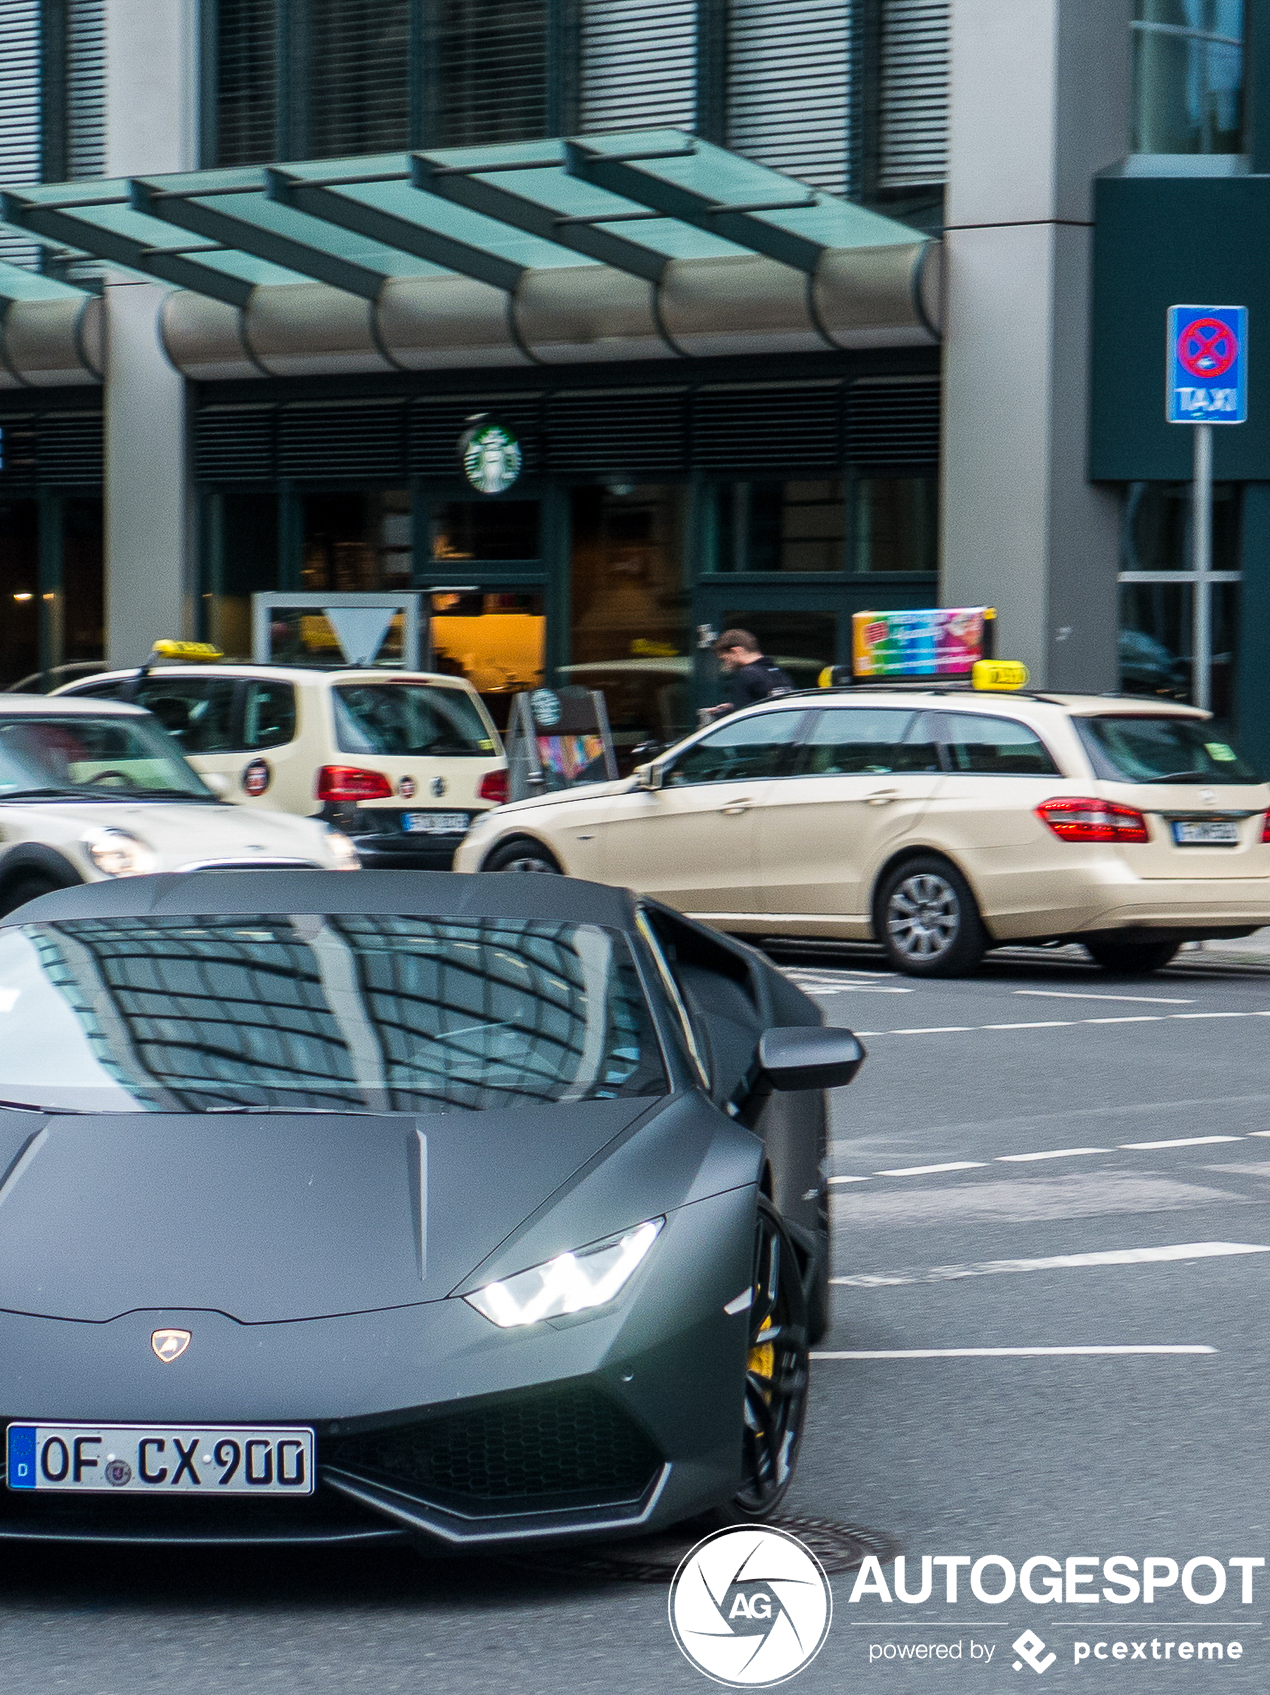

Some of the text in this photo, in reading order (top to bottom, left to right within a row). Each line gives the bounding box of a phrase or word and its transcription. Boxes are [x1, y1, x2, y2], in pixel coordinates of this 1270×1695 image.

[1175, 387, 1237, 411] TAXI
[41, 1436, 304, 1486] OF CX 900
